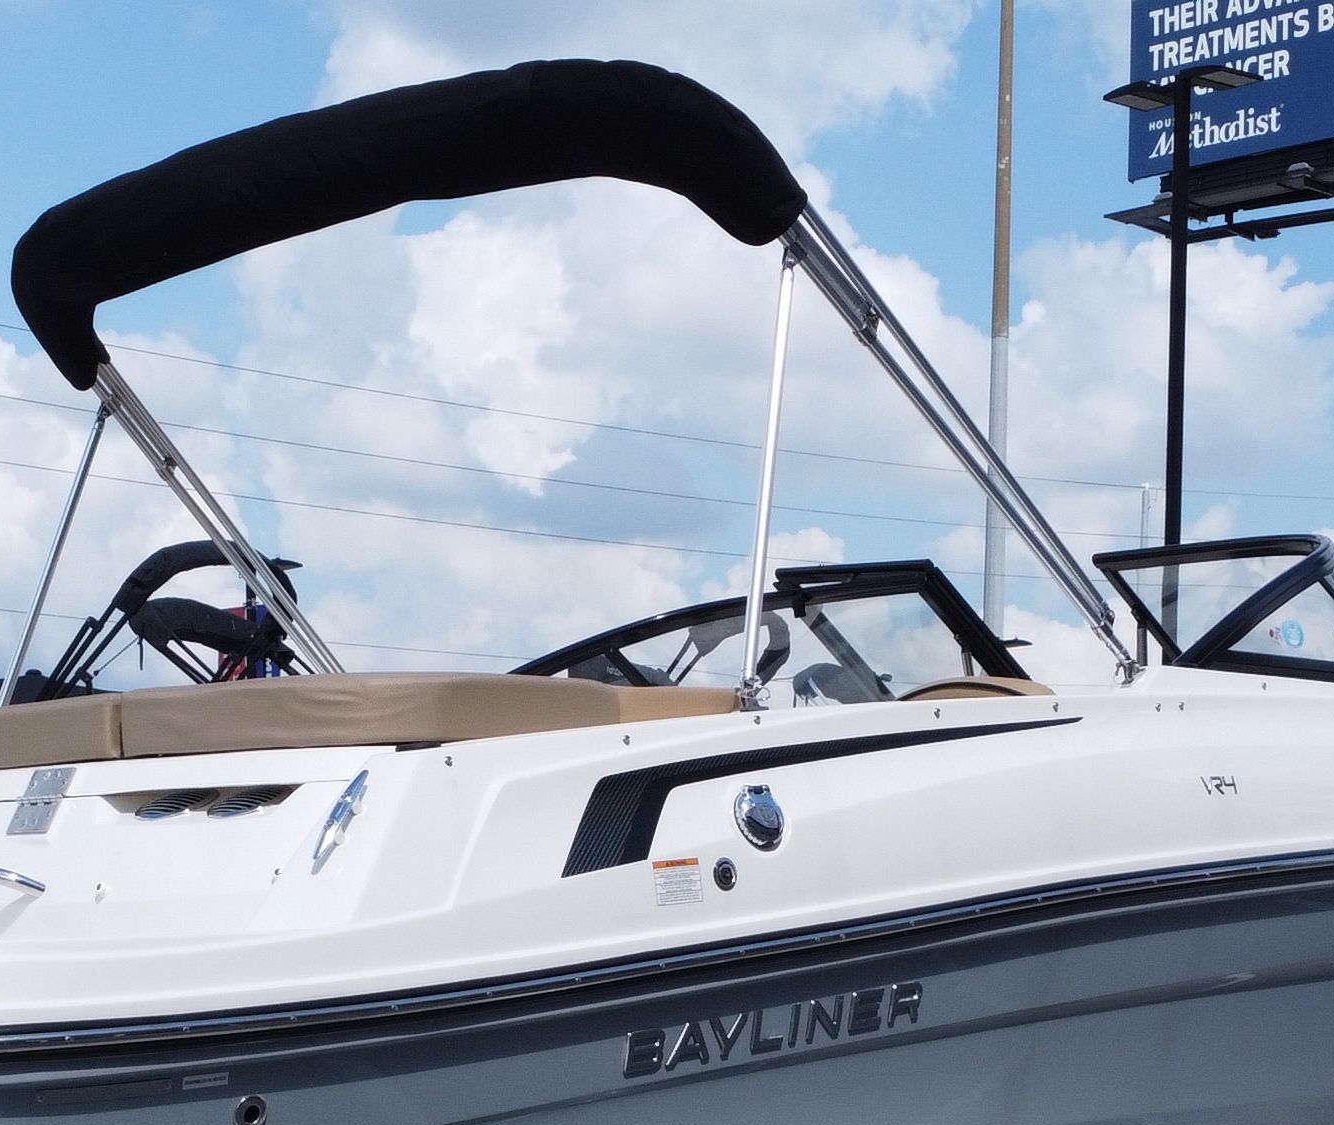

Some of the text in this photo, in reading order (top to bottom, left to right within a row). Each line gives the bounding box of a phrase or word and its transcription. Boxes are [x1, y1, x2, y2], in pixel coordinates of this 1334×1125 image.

[1149, 0, 1218, 36] THEIR
[1149, 9, 1310, 71] TREATMENTS
[1147, 107, 1281, 159] Mthodist
[1200, 775, 1238, 795] VR4
[623, 981, 923, 1079] BAYLINER
